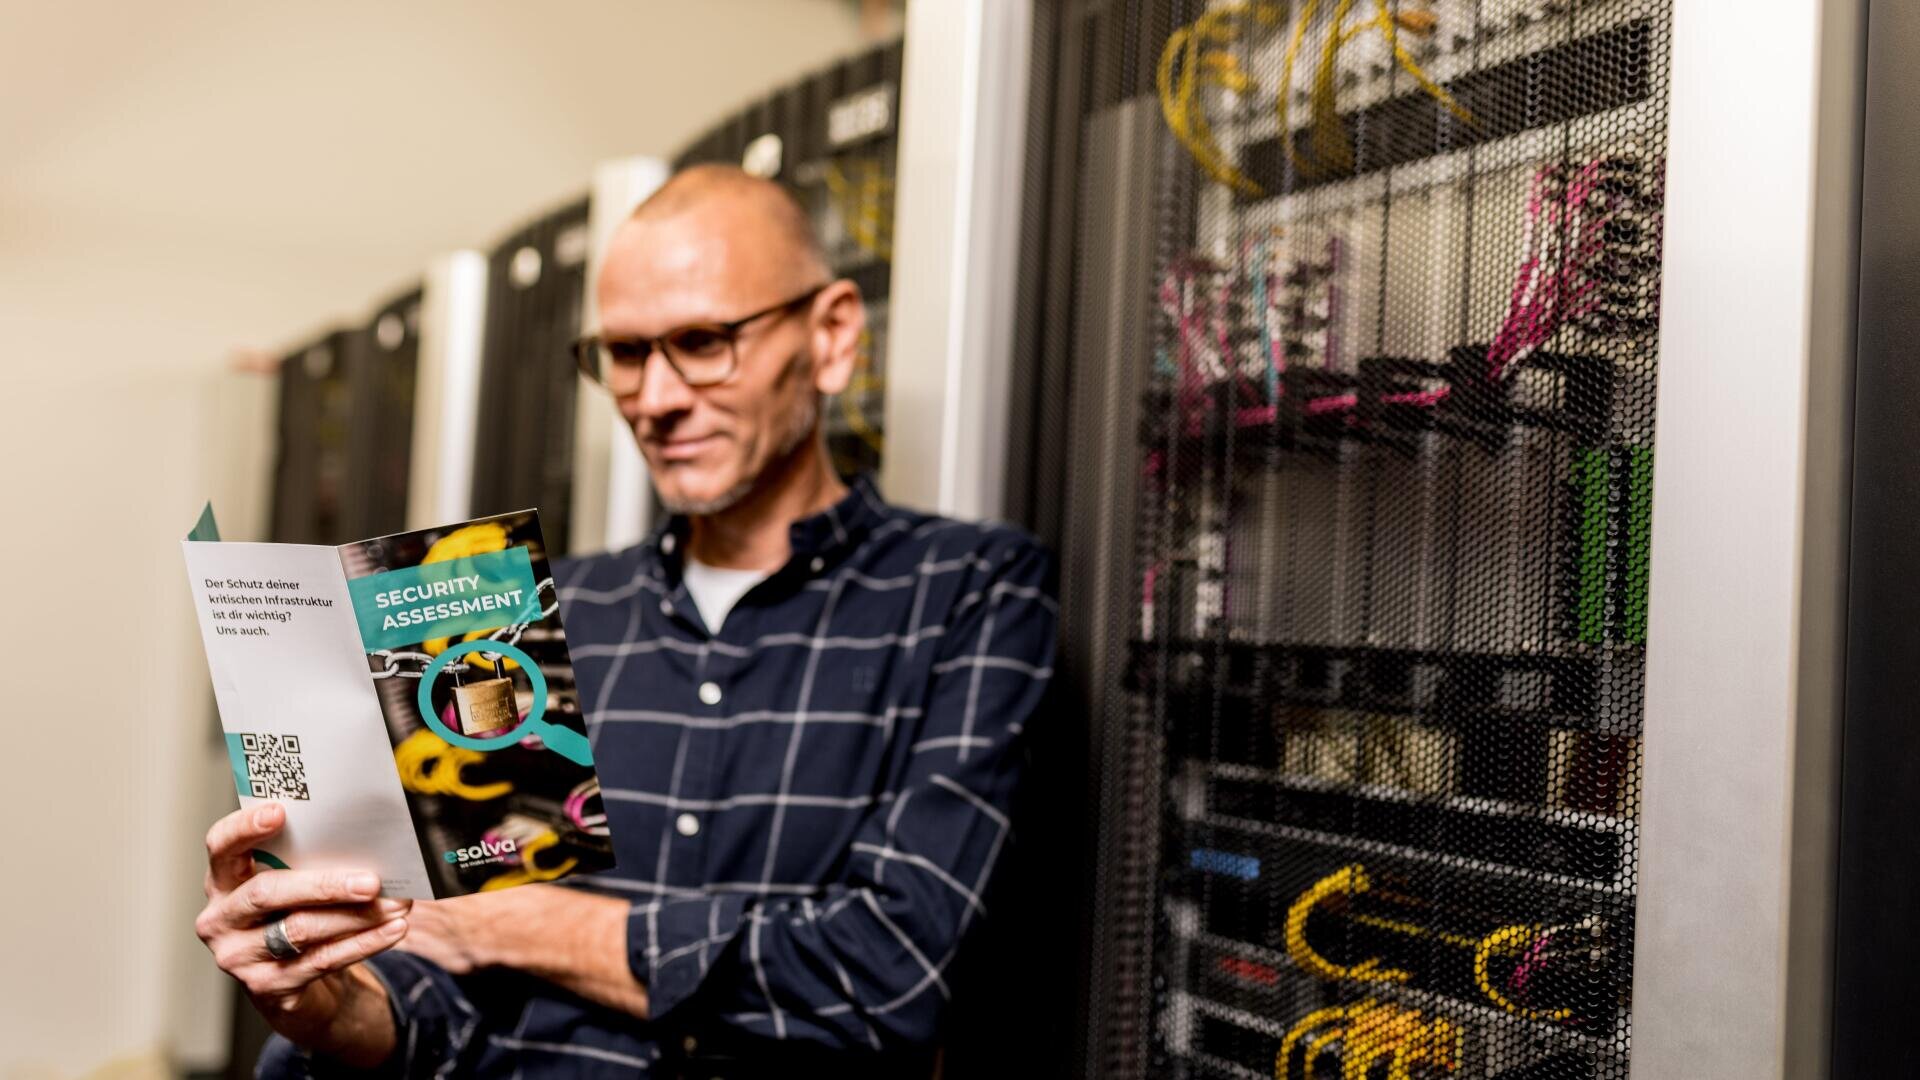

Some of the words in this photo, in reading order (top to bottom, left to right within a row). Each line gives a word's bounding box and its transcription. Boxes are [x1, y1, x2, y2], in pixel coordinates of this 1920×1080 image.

[205, 579, 224, 589] Der
[226, 579, 263, 589] Schutz
[266, 579, 300, 590] deiner
[375, 574, 480, 608] SECURITY
[208, 594, 263, 605] kritischen
[265, 595, 333, 607] Infrastruktur
[212, 609, 226, 620] ist
[228, 610, 243, 620] dir
[245, 610, 292, 623] wichtig?
[382, 589, 523, 630] ASSESSMENT
[216, 626, 238, 636] Uns
[240, 627, 270, 636] auch.
[443, 839, 516, 864] esolva
